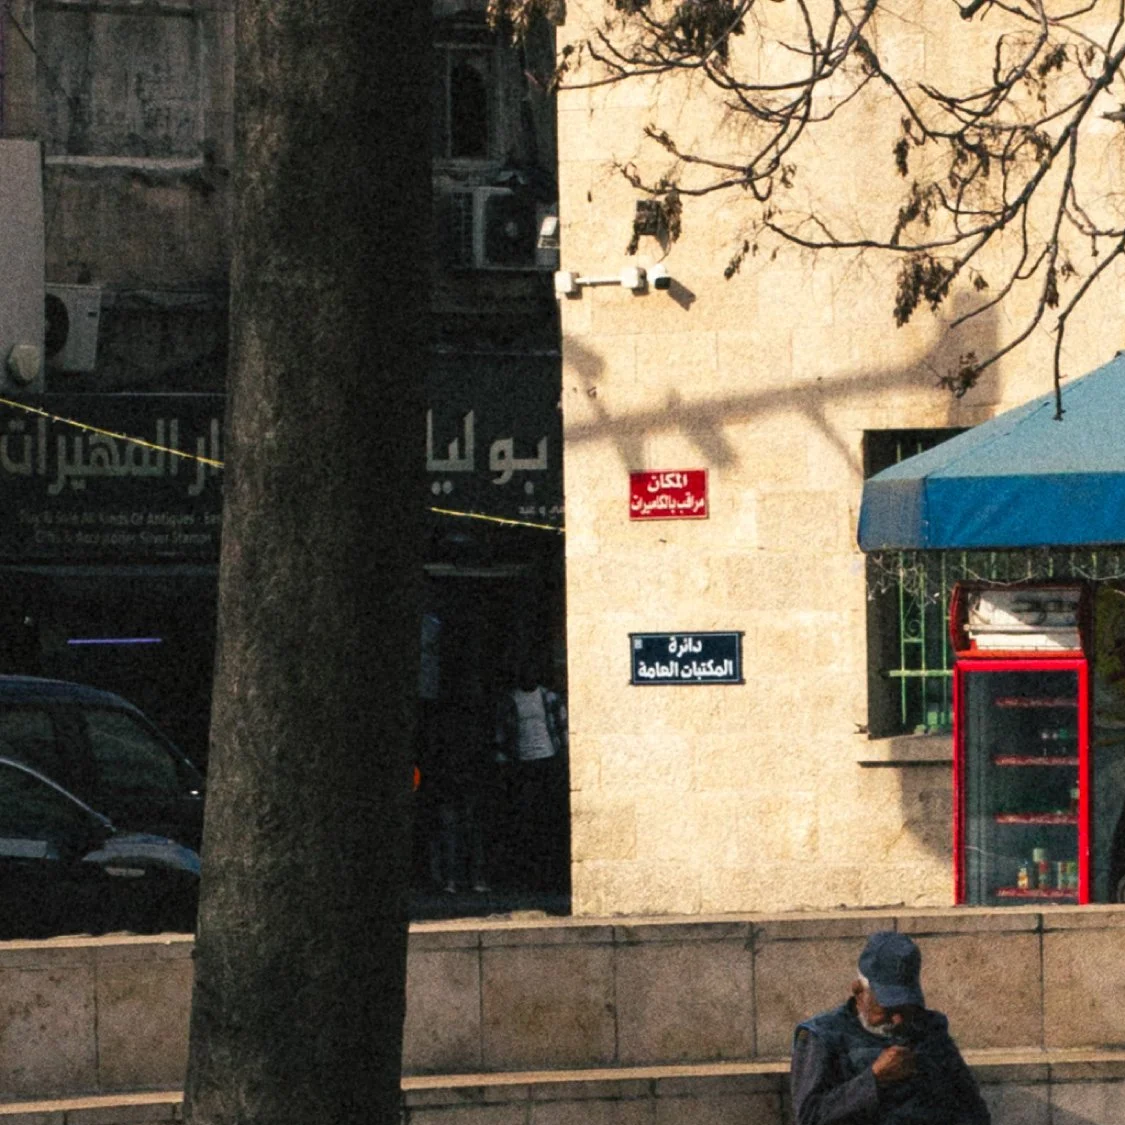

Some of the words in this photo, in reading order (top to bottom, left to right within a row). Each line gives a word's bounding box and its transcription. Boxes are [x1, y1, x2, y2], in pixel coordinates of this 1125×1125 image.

[647, 473, 688, 493] المكان
[631, 494, 677, 515] بالكاميرات
[676, 491, 704, 513] مراقب
[668, 636, 702, 658] دائرة
[637, 661, 679, 679] العامة
[681, 659, 733, 680] المكتبات
